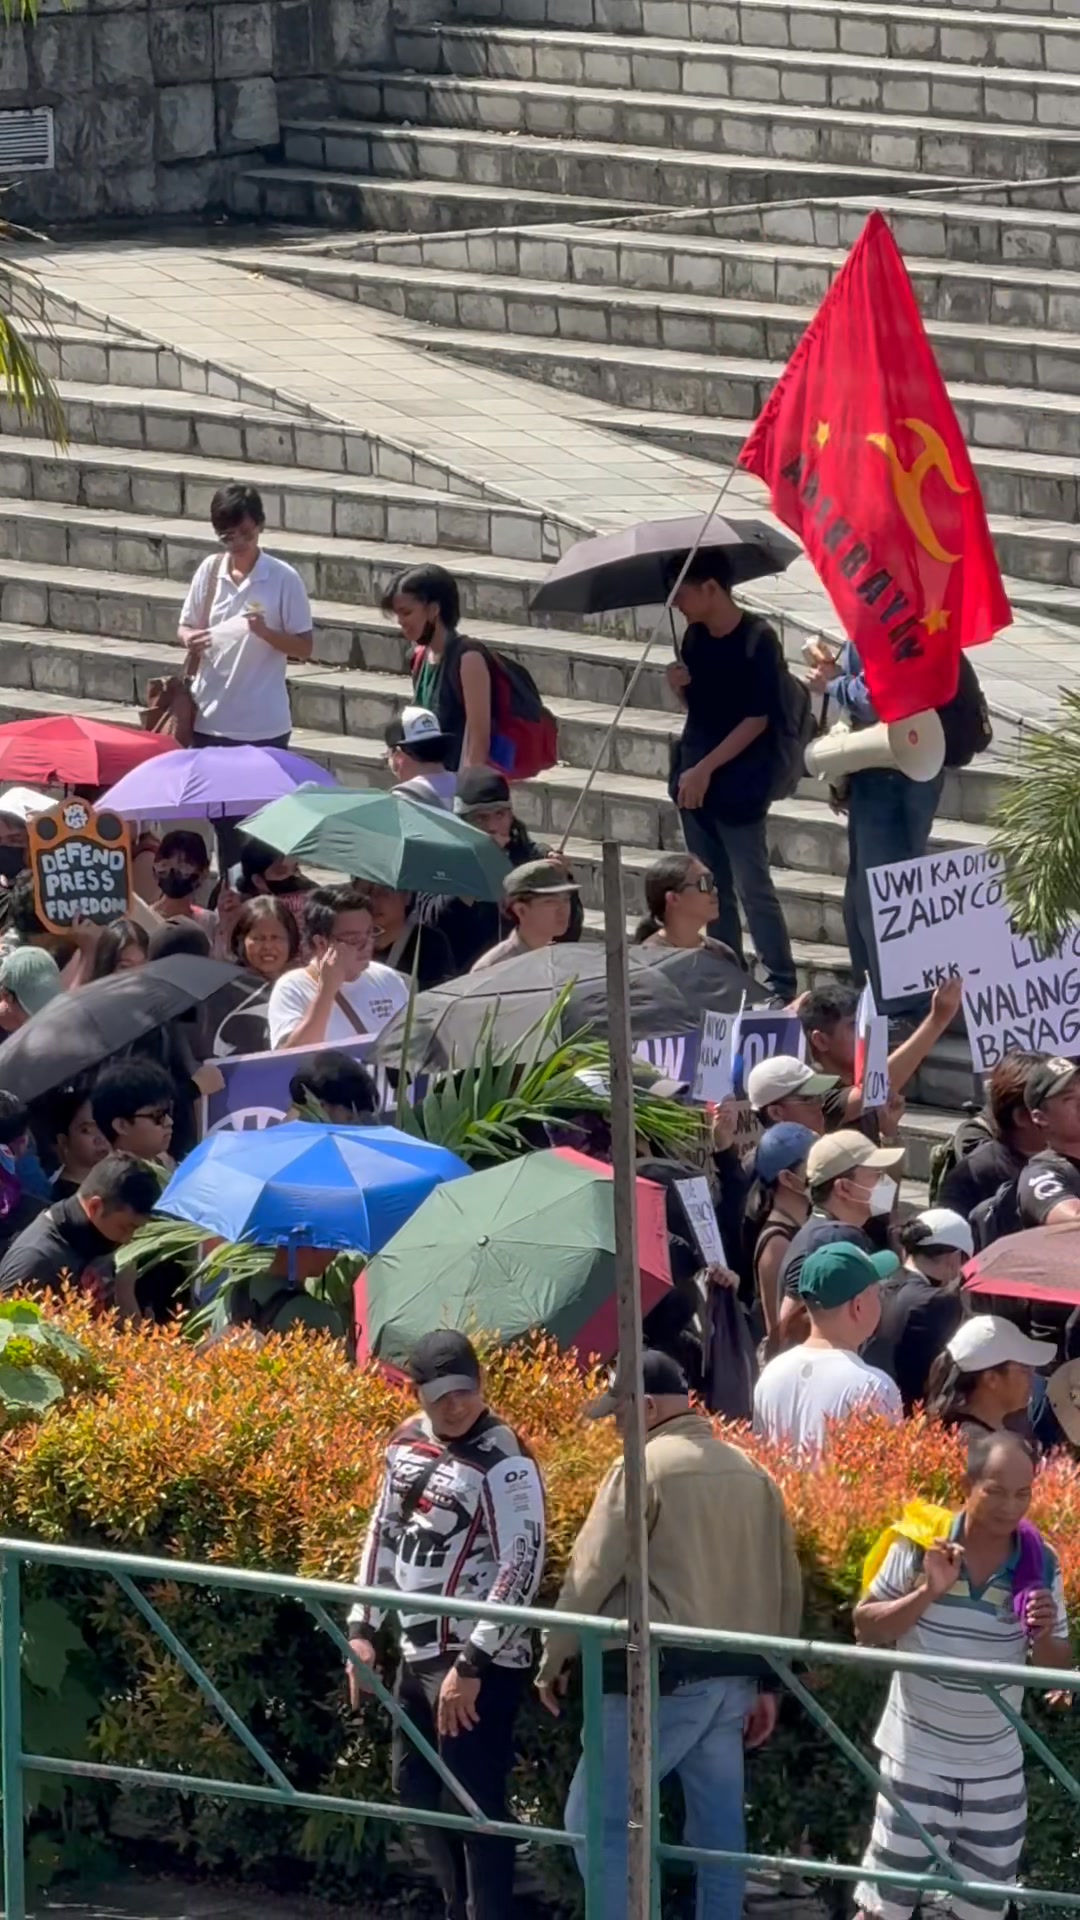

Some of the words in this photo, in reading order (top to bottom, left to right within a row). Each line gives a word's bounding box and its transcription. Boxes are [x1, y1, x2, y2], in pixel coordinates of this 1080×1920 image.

[41, 842, 125, 873] DEFEND
[872, 867, 923, 902] UWI
[931, 858, 961, 887] KA
[964, 853, 1000, 876] DITO
[46, 870, 115, 897] PRESS
[45, 897, 126, 920] FREEDOM
[878, 885, 966, 943] ZALDY
[971, 880, 1003, 909] CO
[922, 962, 961, 989] KKK
[965, 968, 1080, 1028] WALANG
[977, 1009, 1080, 1069] BAYAG
